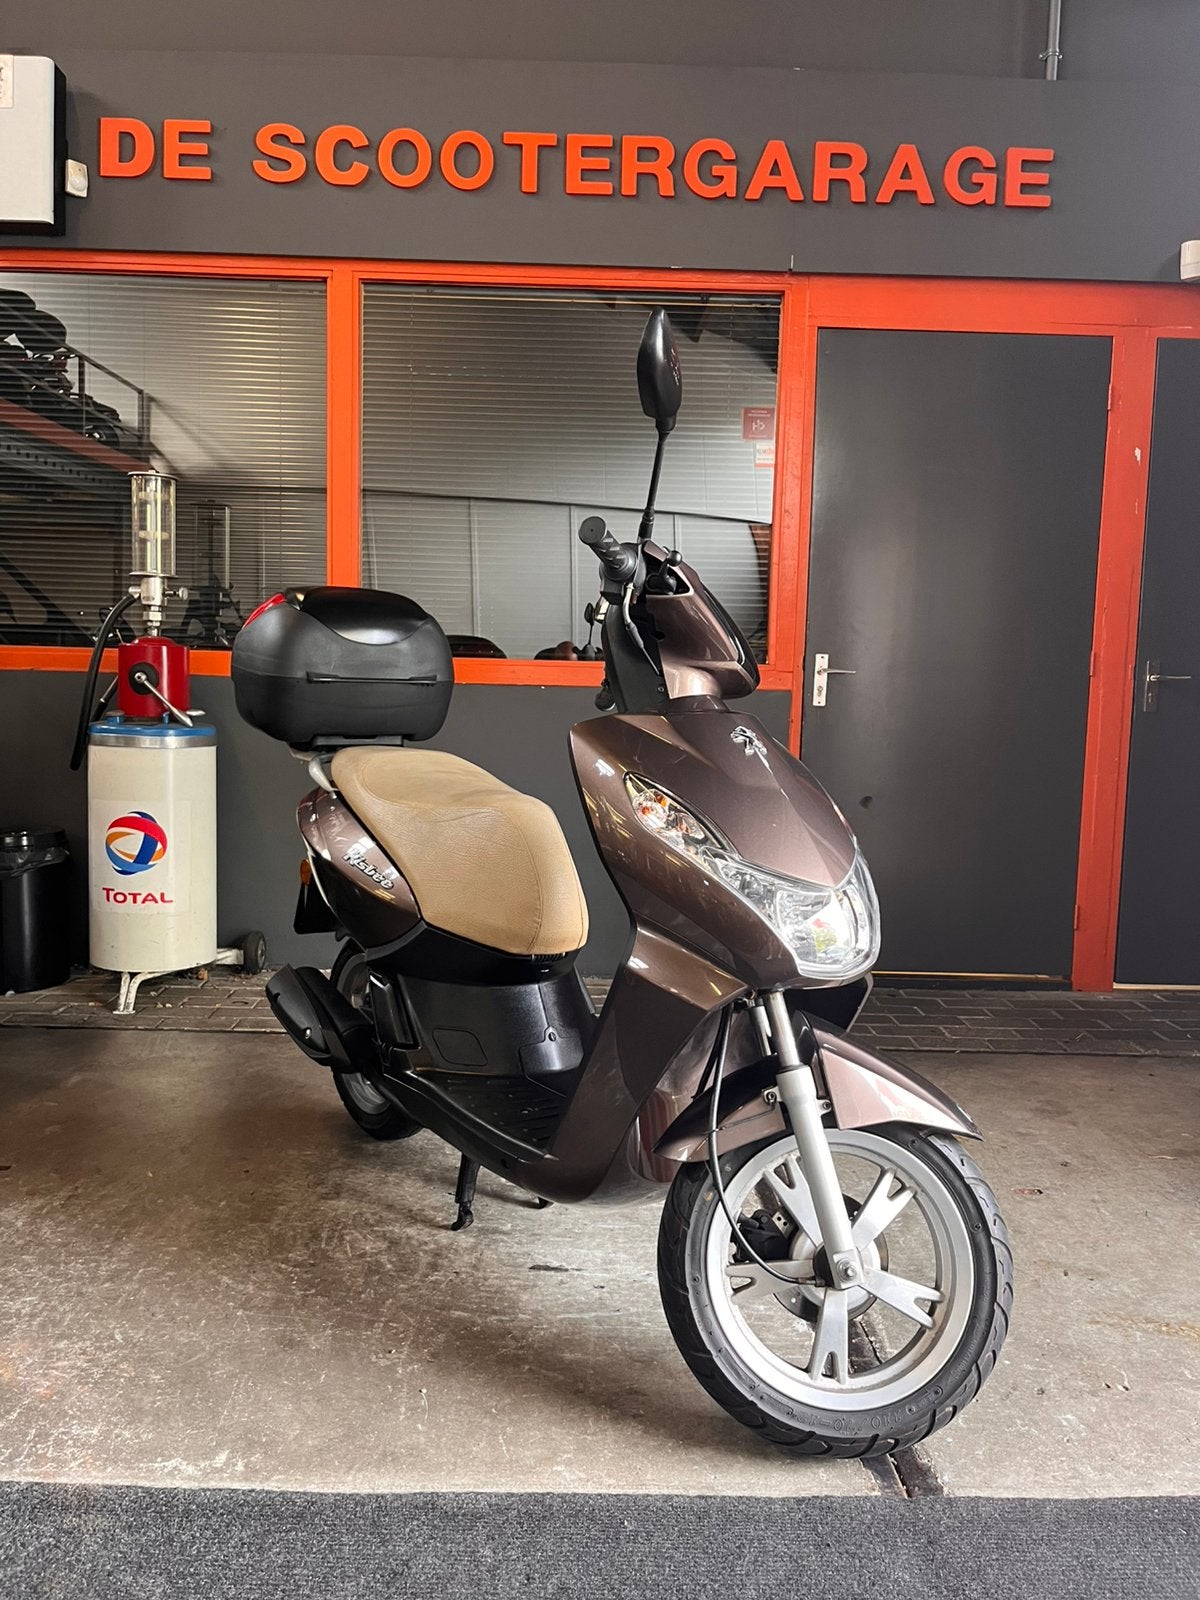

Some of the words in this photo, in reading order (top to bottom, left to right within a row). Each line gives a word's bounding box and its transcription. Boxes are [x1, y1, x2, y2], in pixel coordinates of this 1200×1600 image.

[99, 117, 212, 181] DE
[252, 123, 1054, 208] SCOOTERGARAGE
[102, 887, 173, 904] TOTAL
